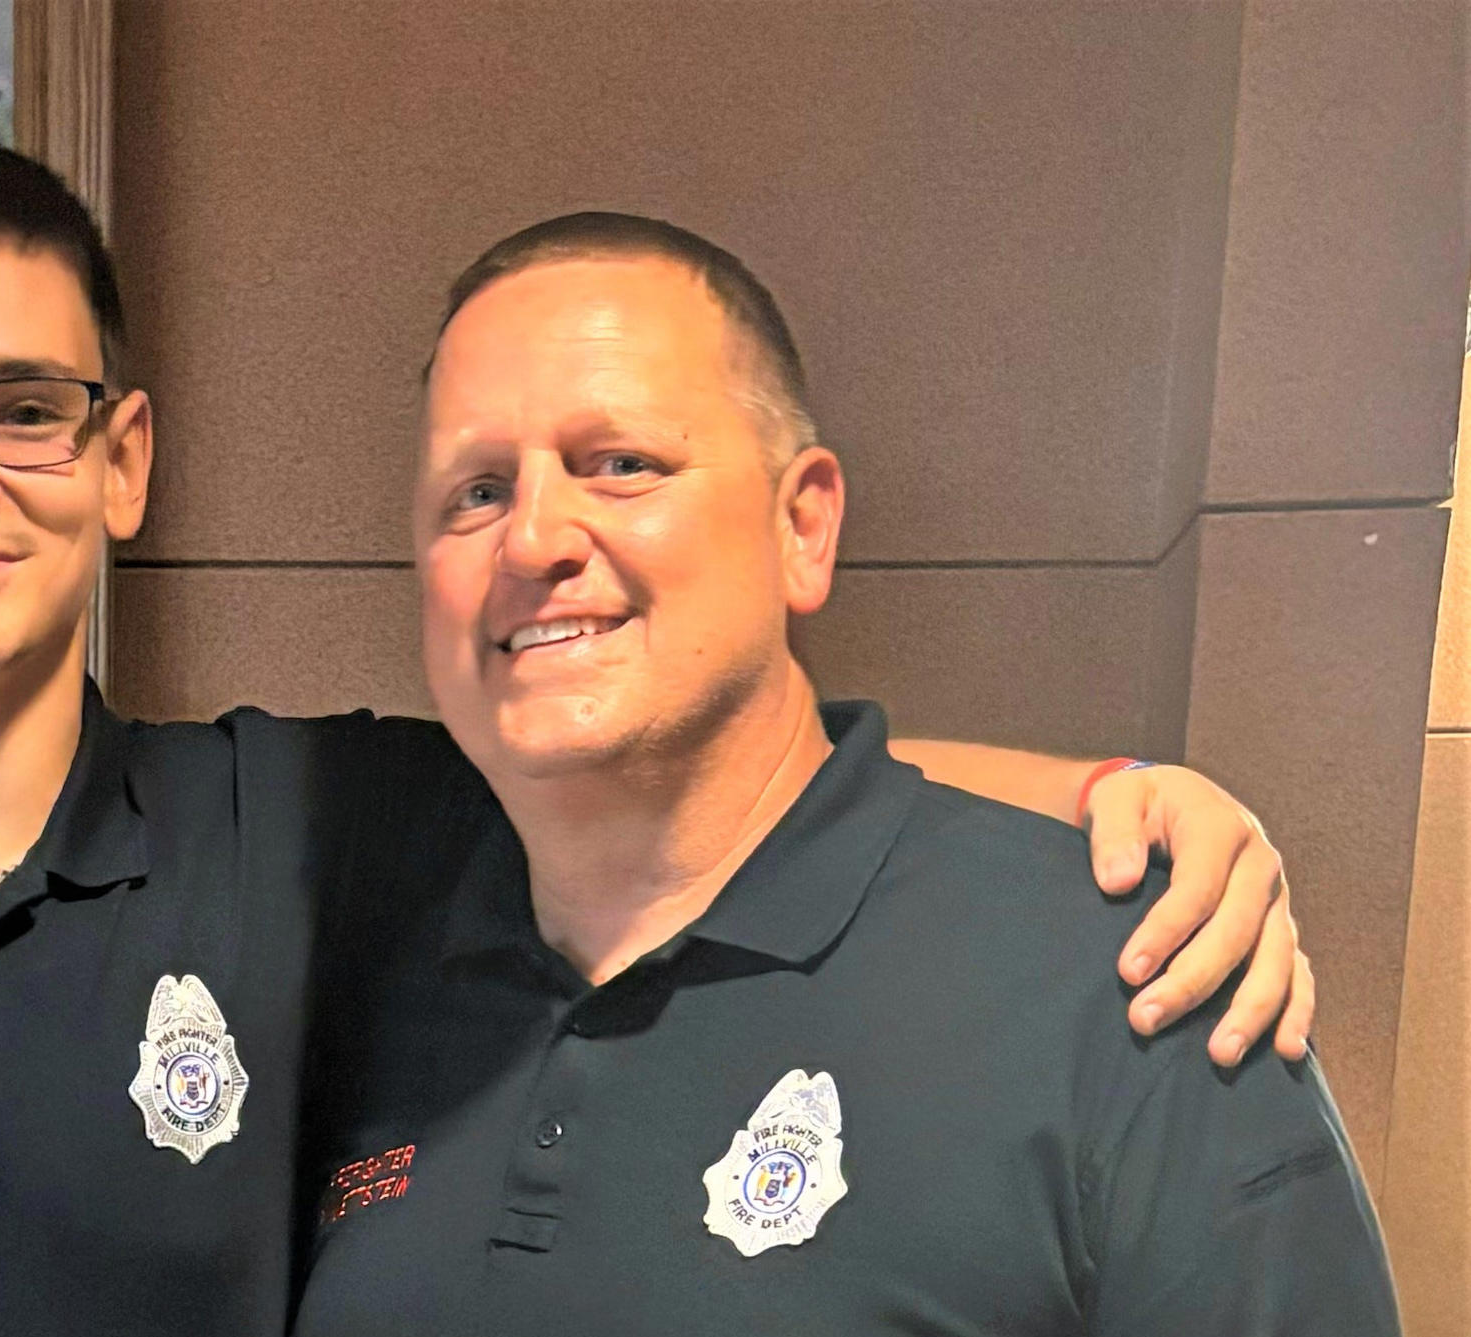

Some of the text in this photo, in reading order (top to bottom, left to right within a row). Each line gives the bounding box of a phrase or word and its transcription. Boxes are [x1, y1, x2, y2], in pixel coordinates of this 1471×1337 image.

[158, 1041, 220, 1069] MILLVILLE
[161, 1105, 189, 1131] FIRE
[753, 1124, 823, 1148] FIRE FIGHTER
[747, 1138, 817, 1166] MILLVILLE
[729, 1198, 802, 1229] FIRE DEPT
